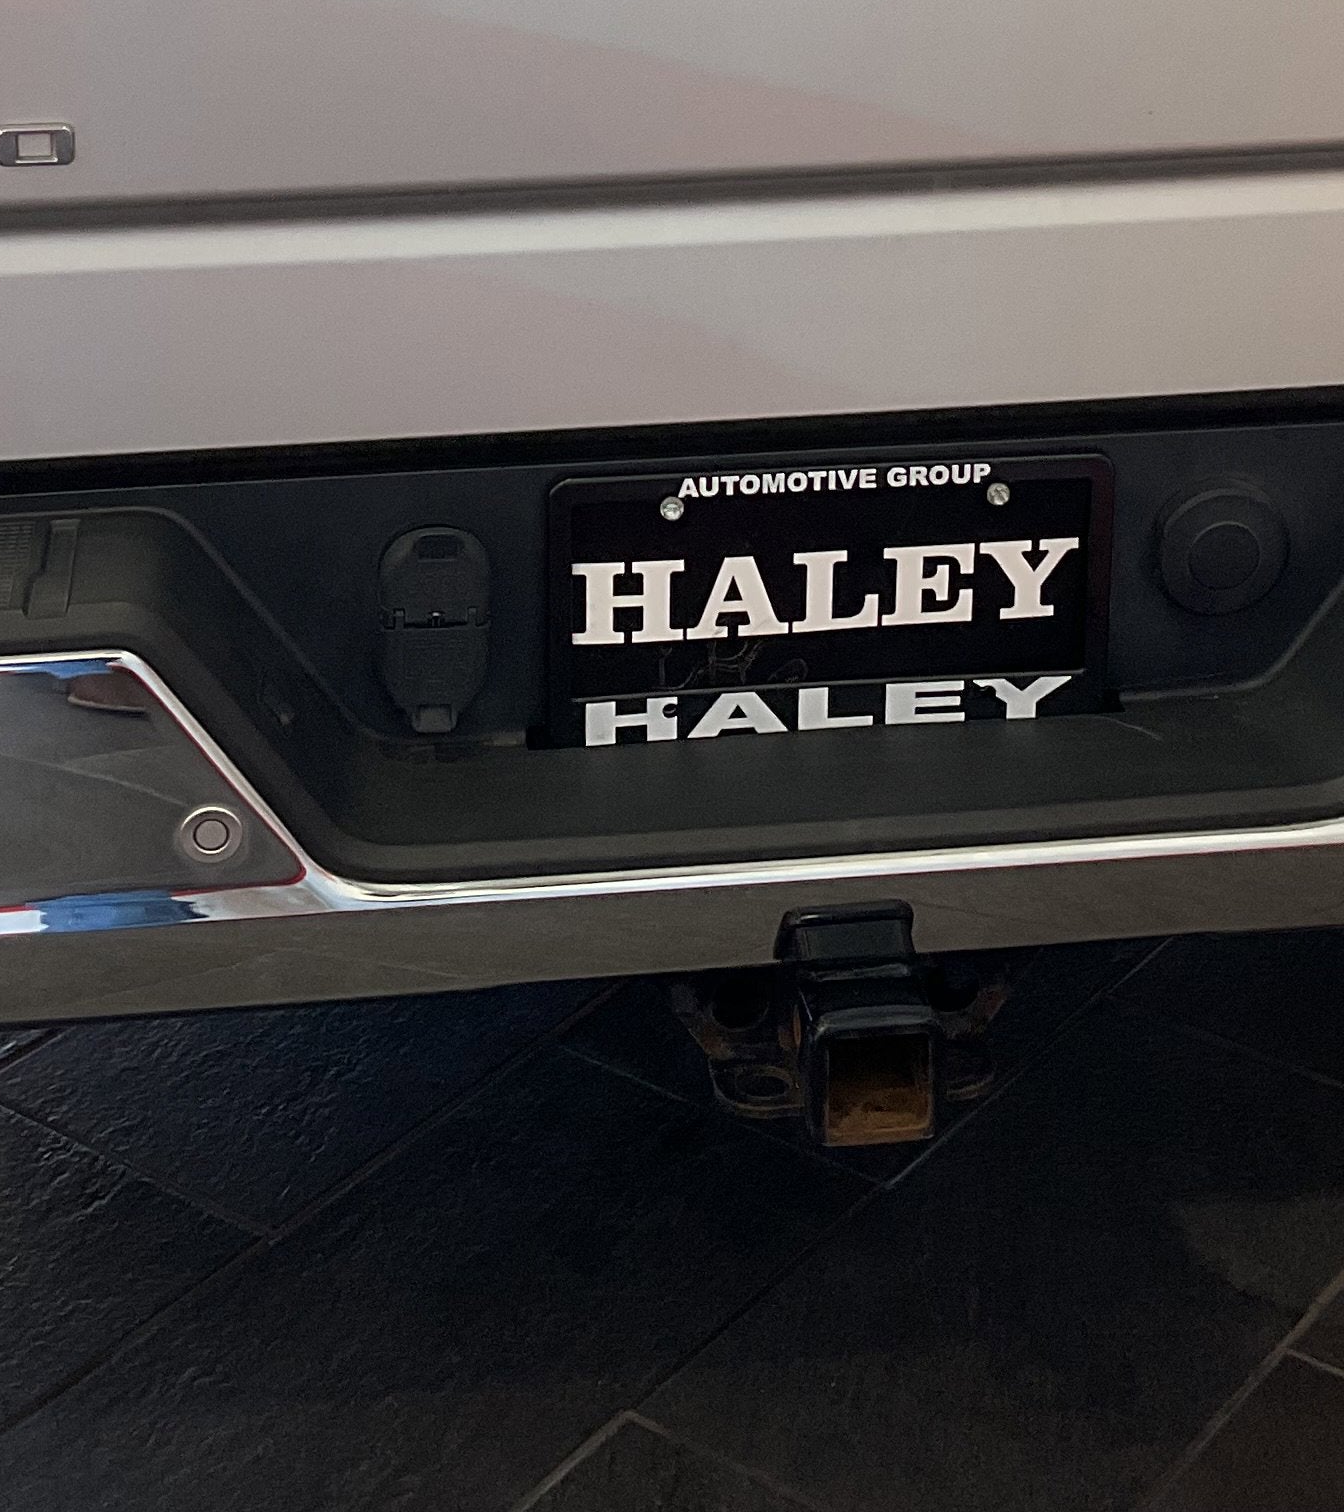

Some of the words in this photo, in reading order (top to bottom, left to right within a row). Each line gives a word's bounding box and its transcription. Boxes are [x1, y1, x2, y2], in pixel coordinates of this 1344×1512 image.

[677, 468, 878, 499] AUTOMOTIVE
[886, 463, 992, 488] GROUP
[572, 537, 1080, 645] HALEY
[585, 675, 1072, 747] HALEY
